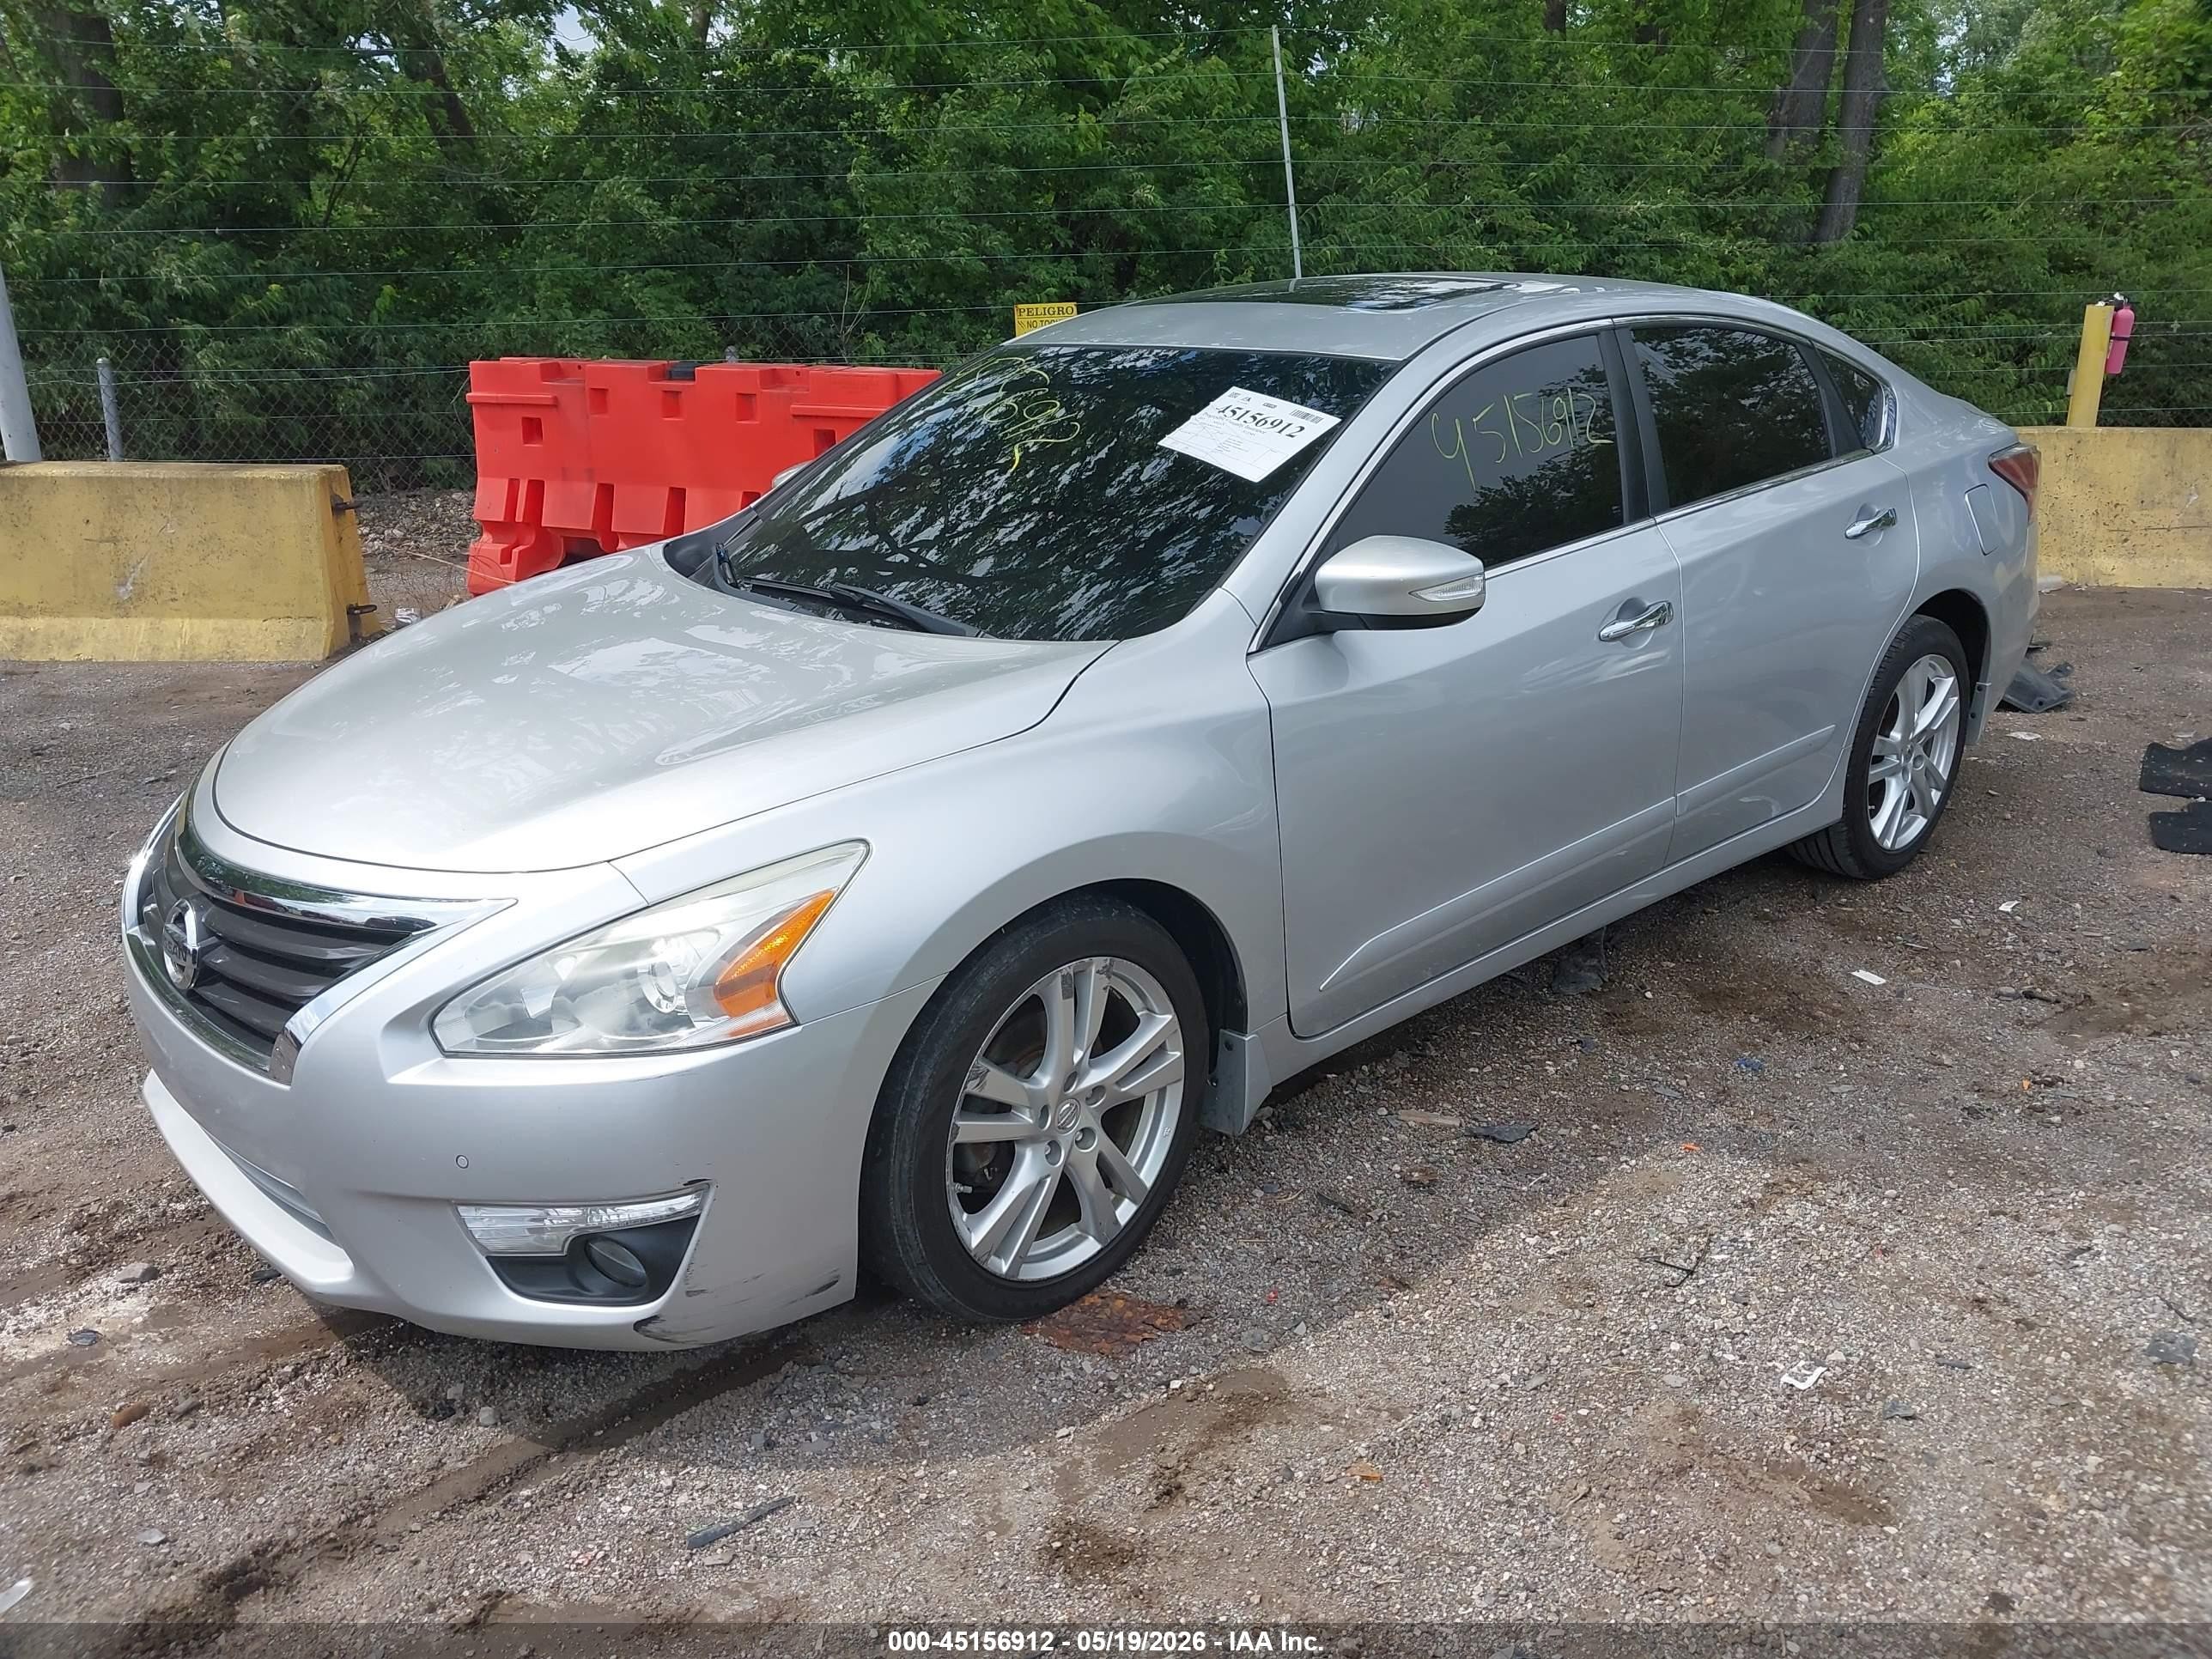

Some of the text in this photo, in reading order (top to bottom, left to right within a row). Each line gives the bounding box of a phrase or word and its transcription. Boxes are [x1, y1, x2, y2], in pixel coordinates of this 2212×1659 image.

[1018, 306, 1074, 317] PELIGRO
[1026, 320, 1038, 329] NO
[1216, 404, 1305, 439] 45156912
[1431, 387, 1614, 490] 45156912
